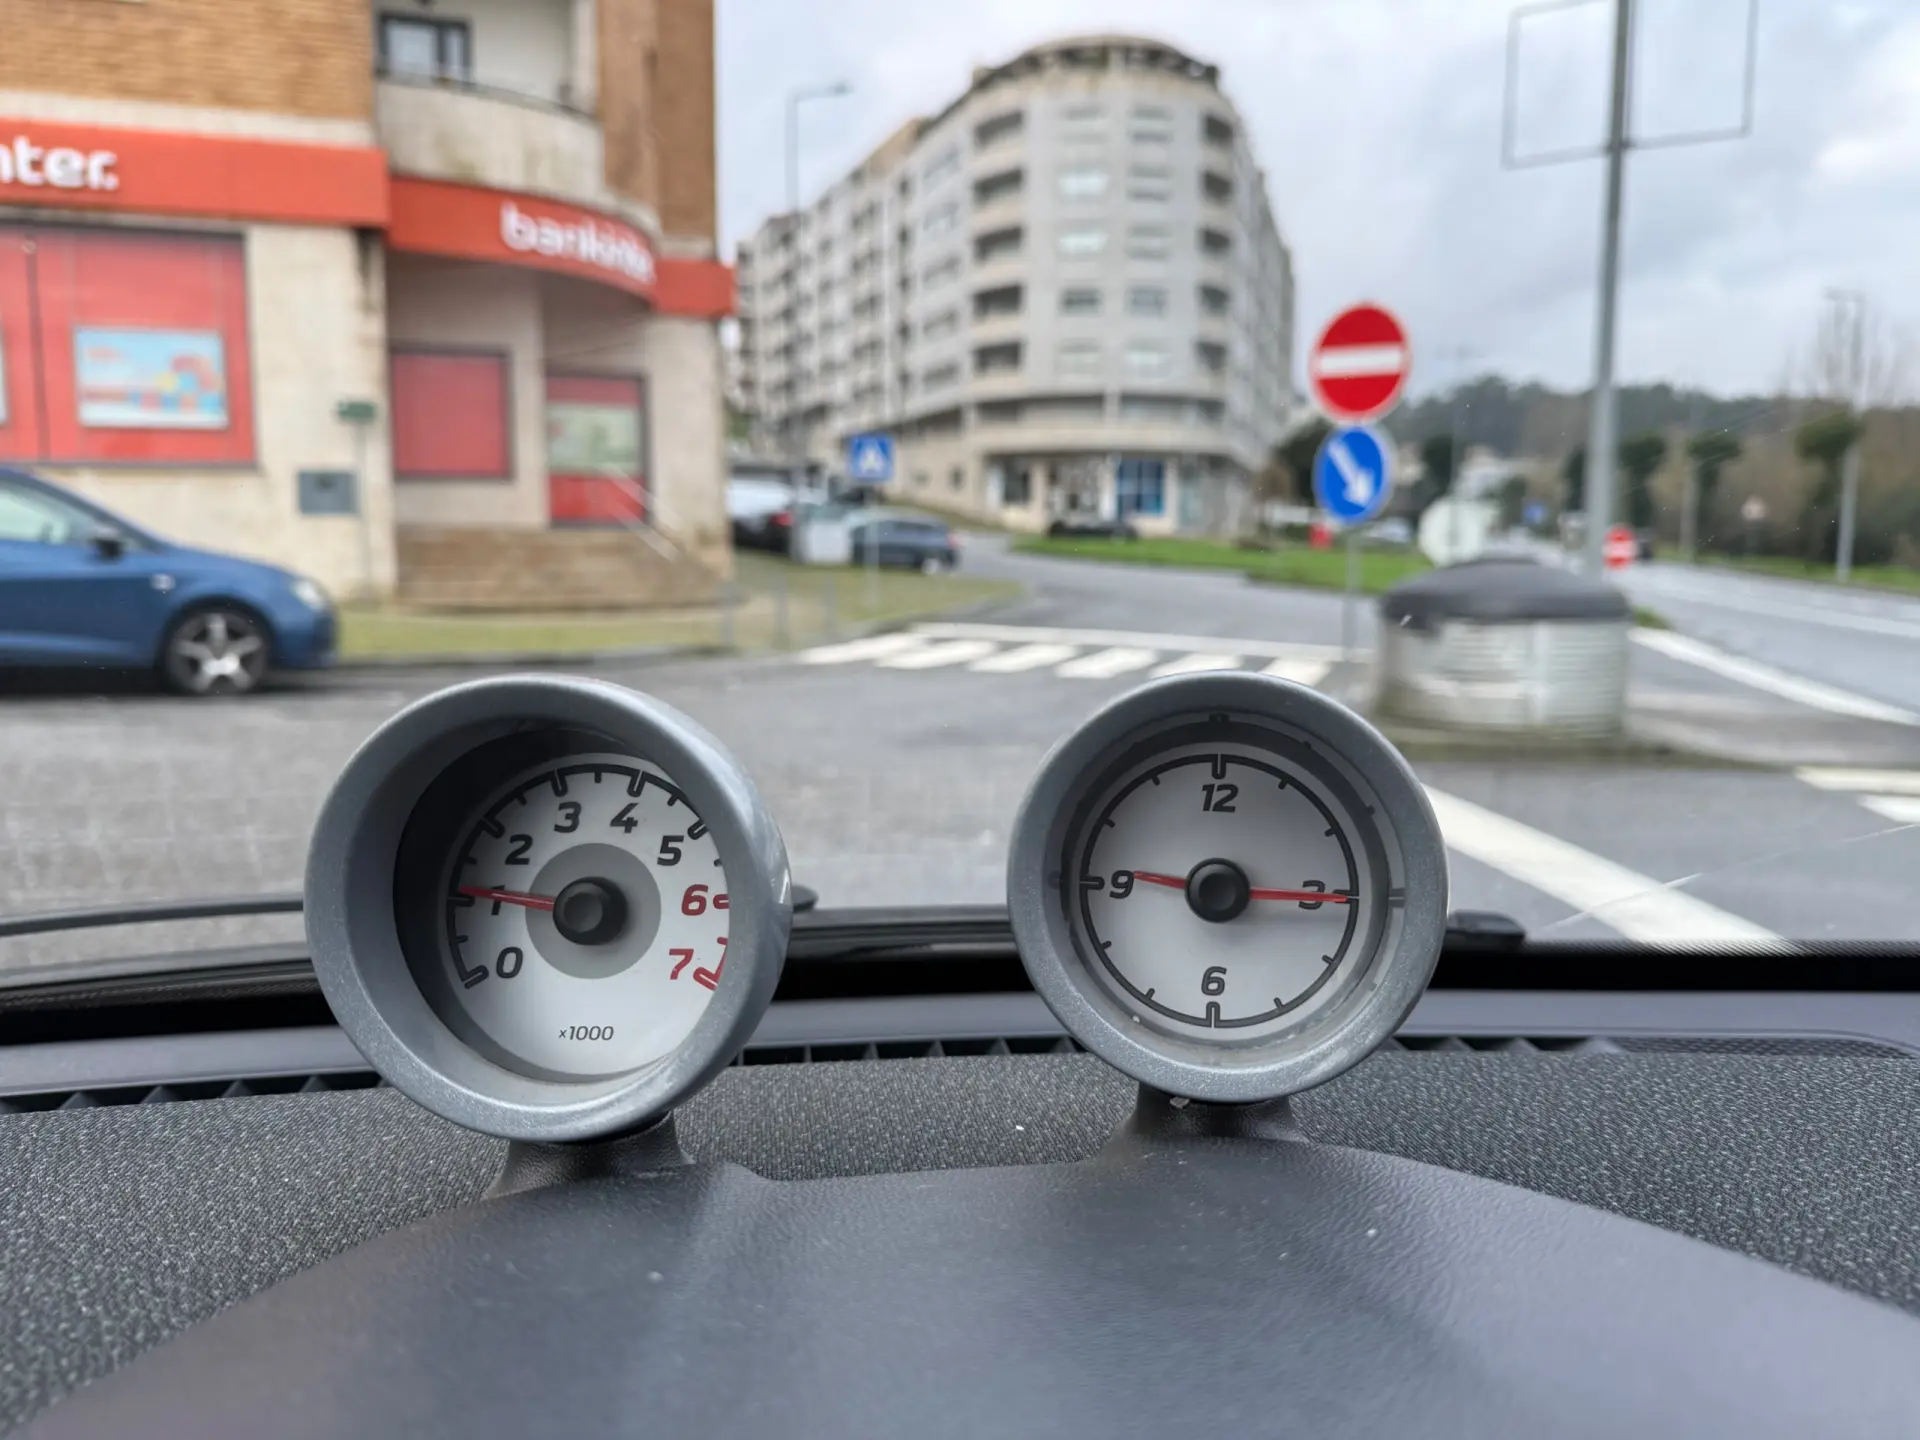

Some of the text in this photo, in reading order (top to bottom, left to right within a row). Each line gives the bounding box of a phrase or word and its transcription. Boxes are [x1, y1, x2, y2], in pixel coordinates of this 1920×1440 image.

[1201, 784, 1239, 812] 12
[554, 802, 582, 833] 3
[610, 803, 639, 833] 4
[504, 834, 533, 865] 2
[657, 835, 684, 866] 5
[681, 884, 709, 916] 6
[1109, 870, 1134, 899] 9
[1298, 880, 1325, 910] 3
[491, 885, 505, 916] 1
[496, 947, 523, 979] 0
[668, 948, 694, 980] 7
[1201, 966, 1227, 996] 6
[559, 1026, 614, 1041] x1000
